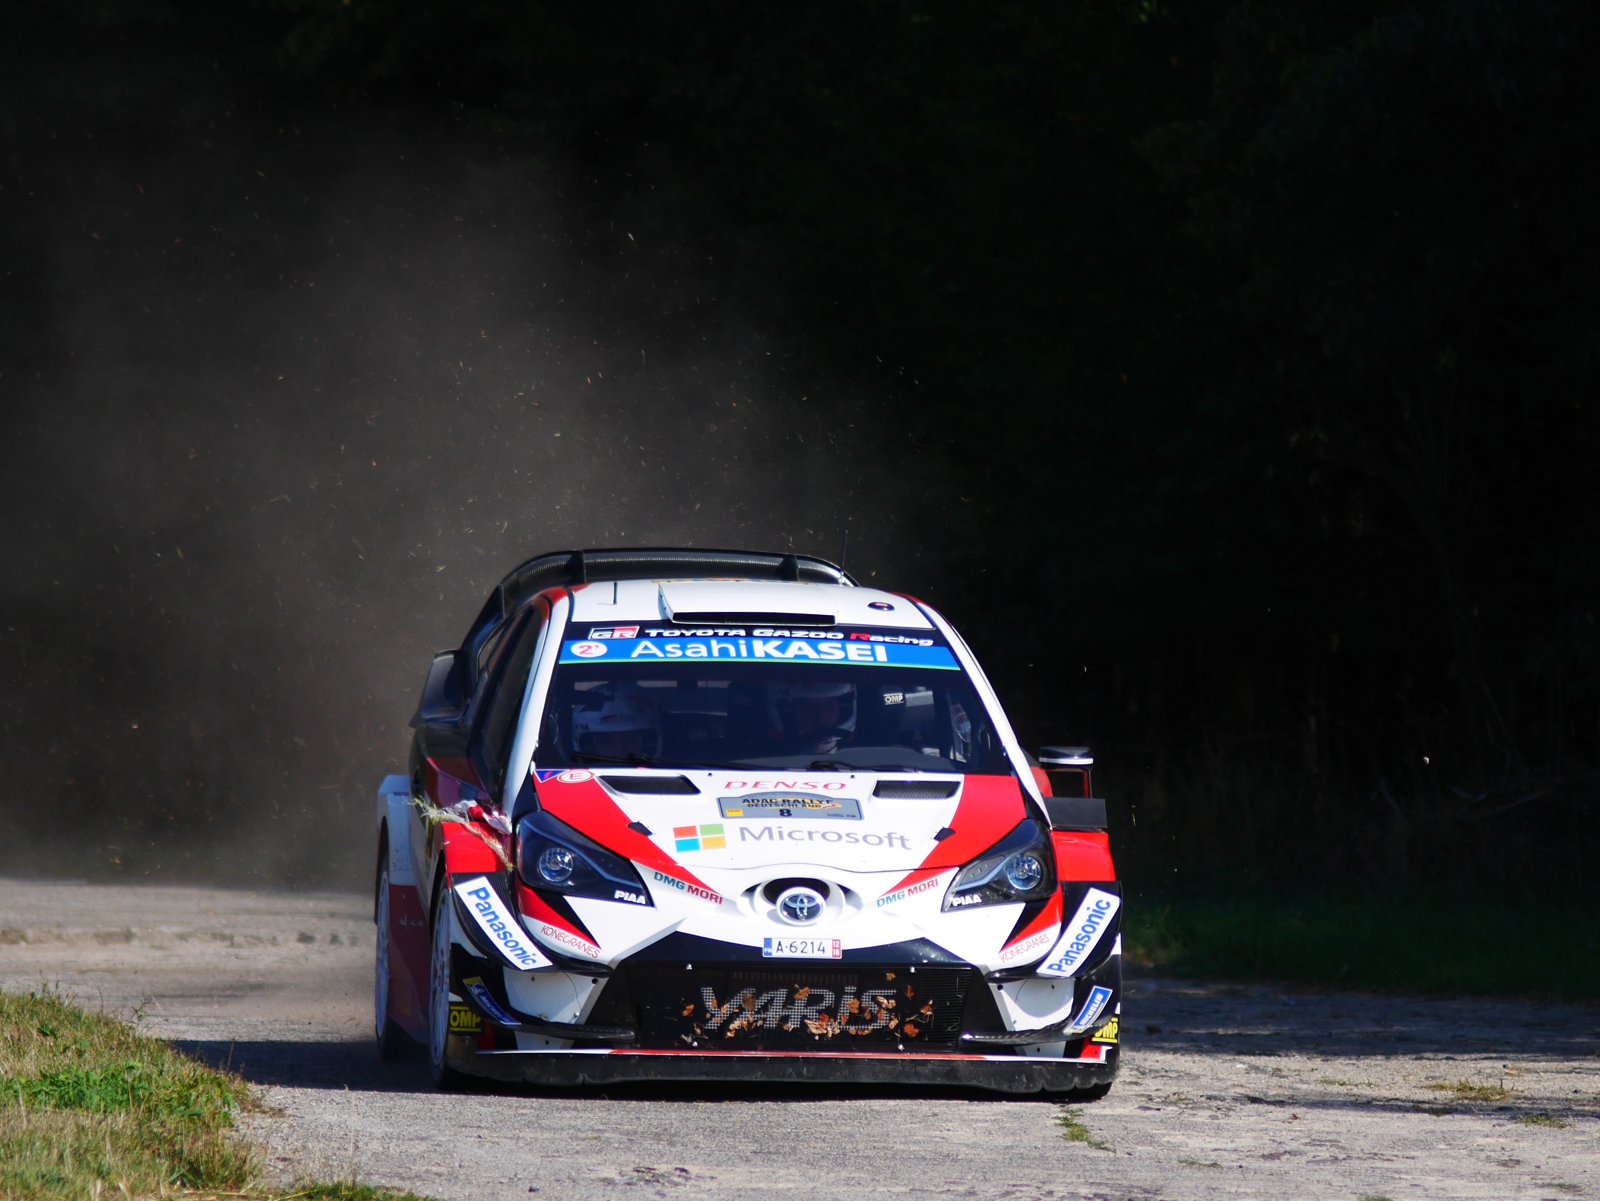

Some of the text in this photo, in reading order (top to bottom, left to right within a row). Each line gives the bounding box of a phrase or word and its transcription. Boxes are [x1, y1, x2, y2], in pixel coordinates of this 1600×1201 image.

[592, 630, 636, 639] GR
[645, 628, 933, 646] TOYOTA GAZOO Racing
[725, 781, 847, 791] DENSO
[779, 808, 793, 818] 8
[739, 826, 913, 850] Microsoft
[614, 889, 647, 905] PIAA
[653, 871, 724, 905] DMG MORI
[876, 878, 940, 908] DMG MORI
[951, 894, 983, 907] PIAA
[467, 885, 538, 966] Panasonic
[1047, 898, 1112, 973] Panasonic
[541, 925, 601, 959] KONECRANES
